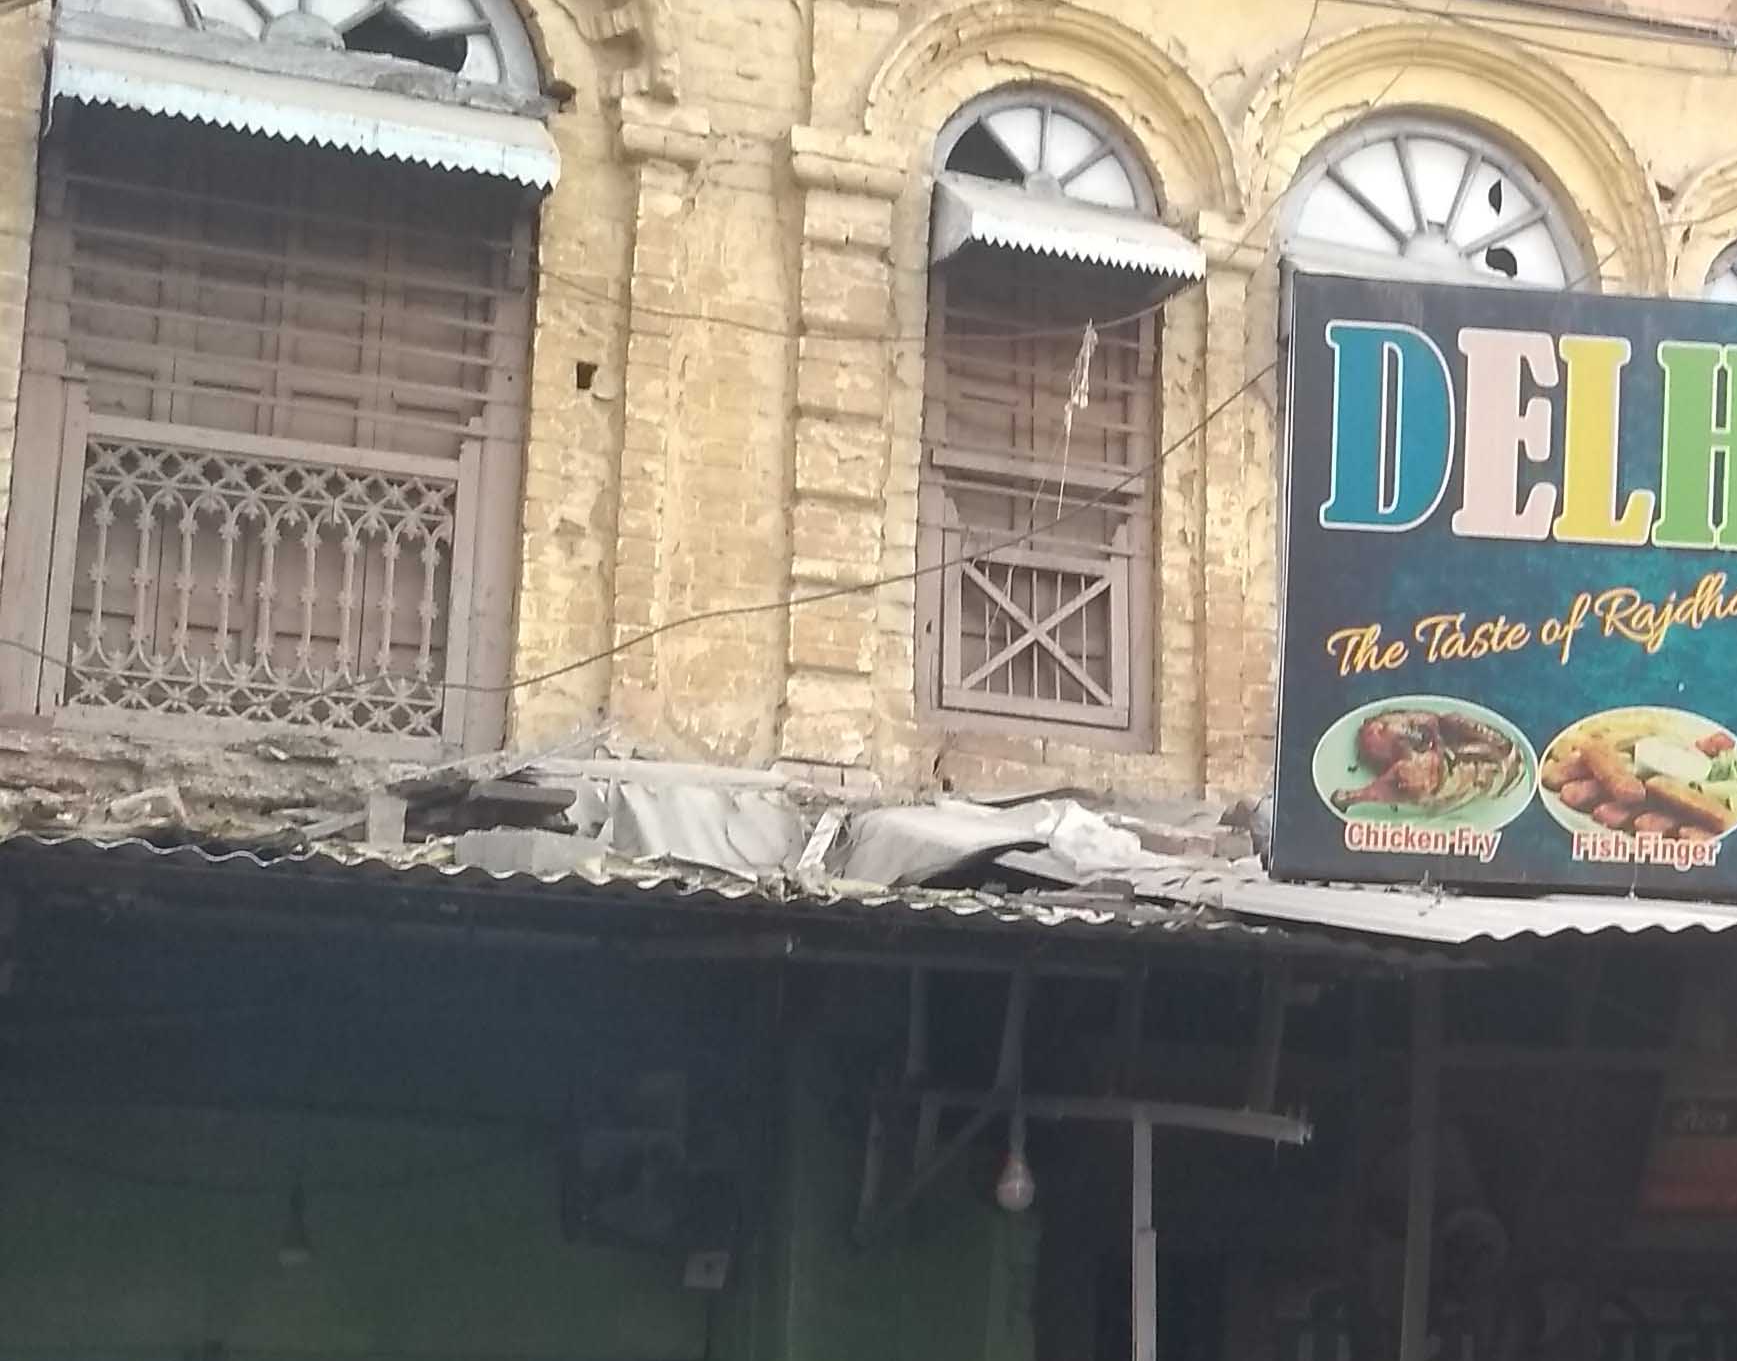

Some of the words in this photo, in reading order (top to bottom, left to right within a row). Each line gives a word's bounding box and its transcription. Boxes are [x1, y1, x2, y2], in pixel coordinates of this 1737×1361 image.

[1327, 625, 1408, 676] The
[1415, 613, 1530, 661] Taste
[1541, 593, 1588, 665] of
